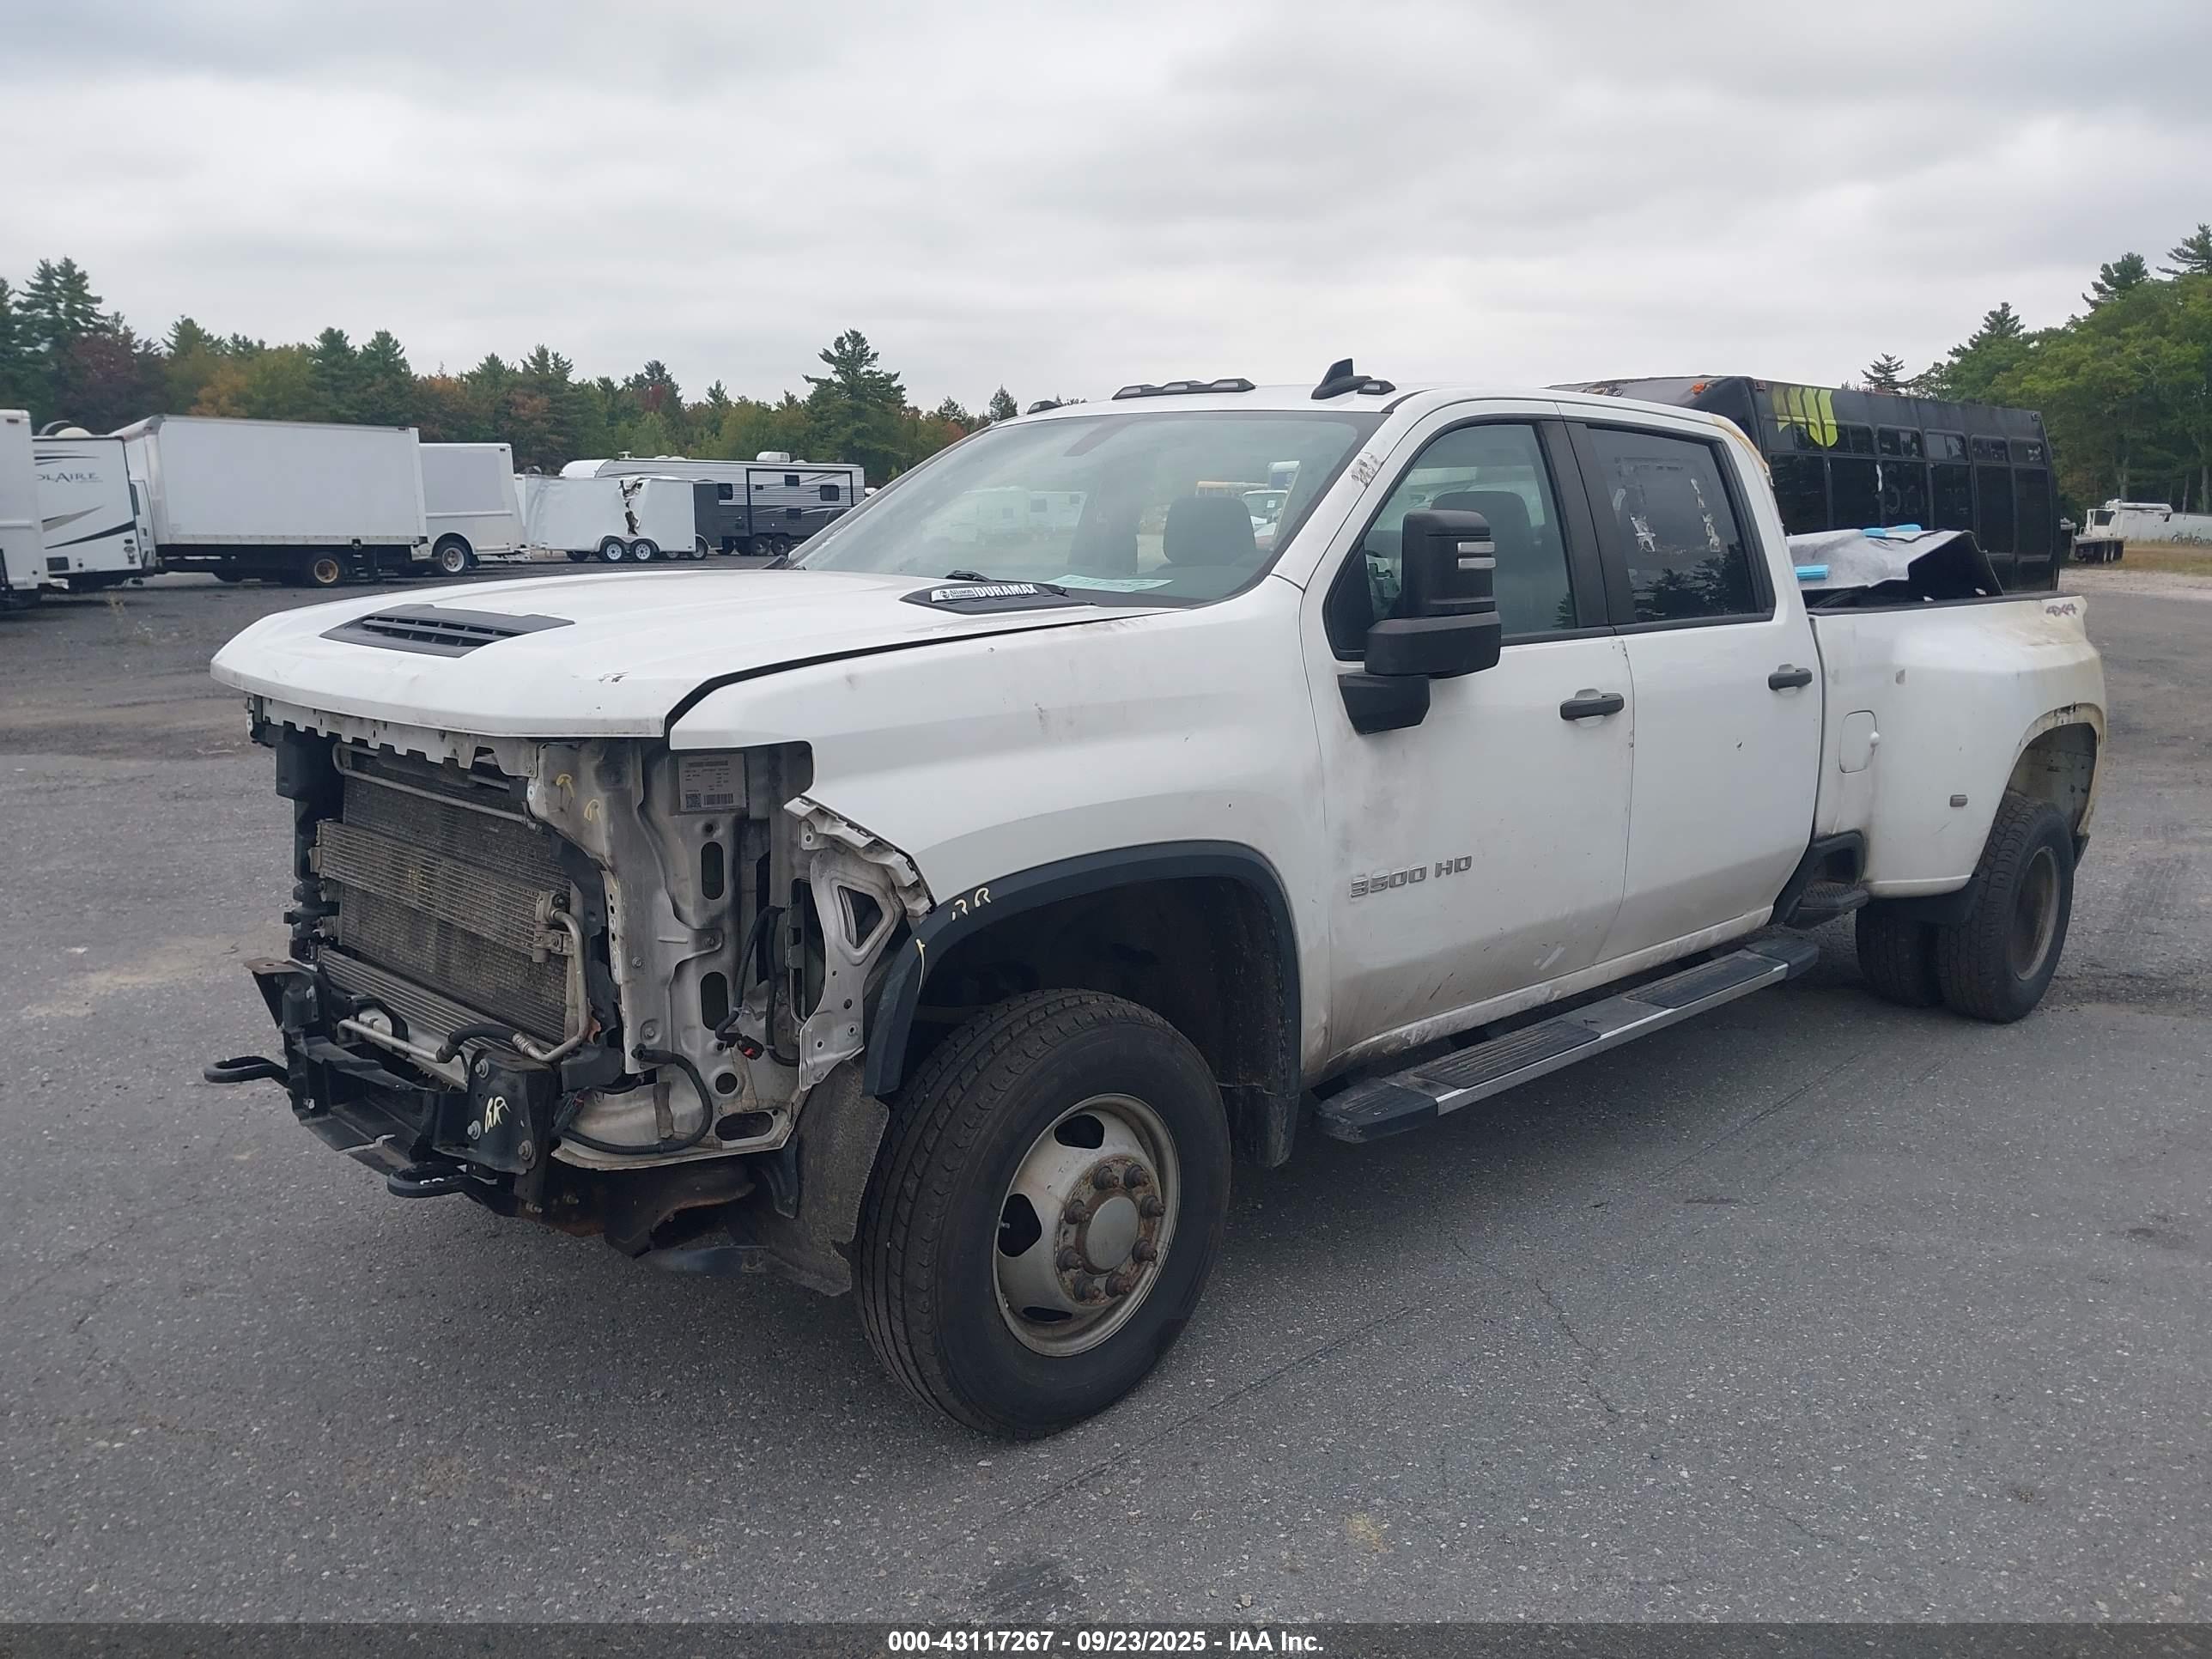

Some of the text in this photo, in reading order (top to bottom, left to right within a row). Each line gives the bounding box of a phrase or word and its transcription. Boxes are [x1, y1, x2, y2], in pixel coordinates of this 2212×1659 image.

[35, 472, 100, 483] OLAIRE
[974, 583, 1039, 598] DURAMAX
[1351, 855, 1473, 898] 3500 HD
